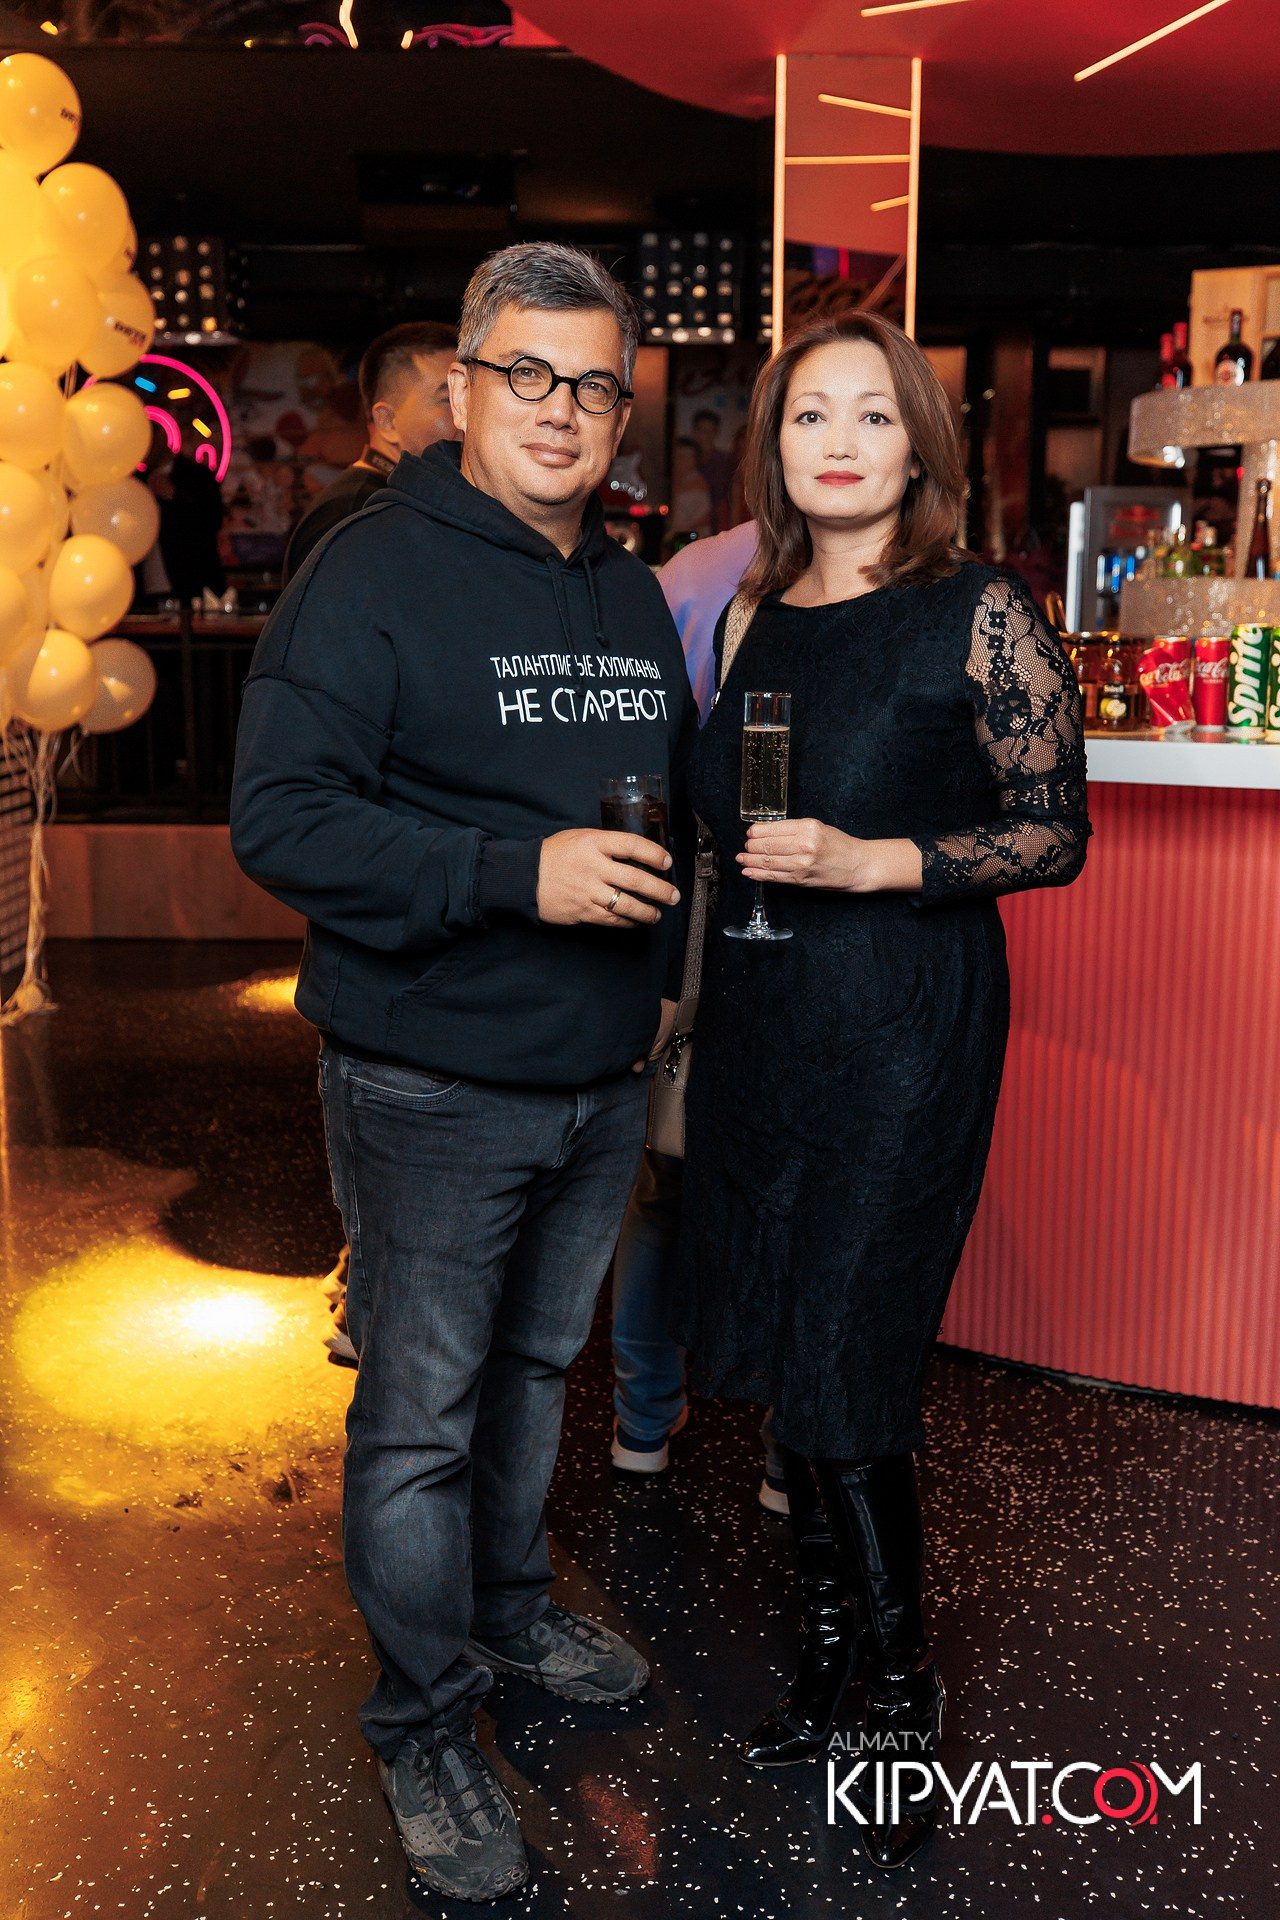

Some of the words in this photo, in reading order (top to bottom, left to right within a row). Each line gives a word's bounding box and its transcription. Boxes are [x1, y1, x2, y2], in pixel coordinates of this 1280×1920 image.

[596, 655, 661, 680] ХУЛИГАНЫ
[1228, 622, 1265, 727] Sprite
[498, 688, 543, 725] НЕ
[551, 687, 668, 723] СТАРЕЮТ
